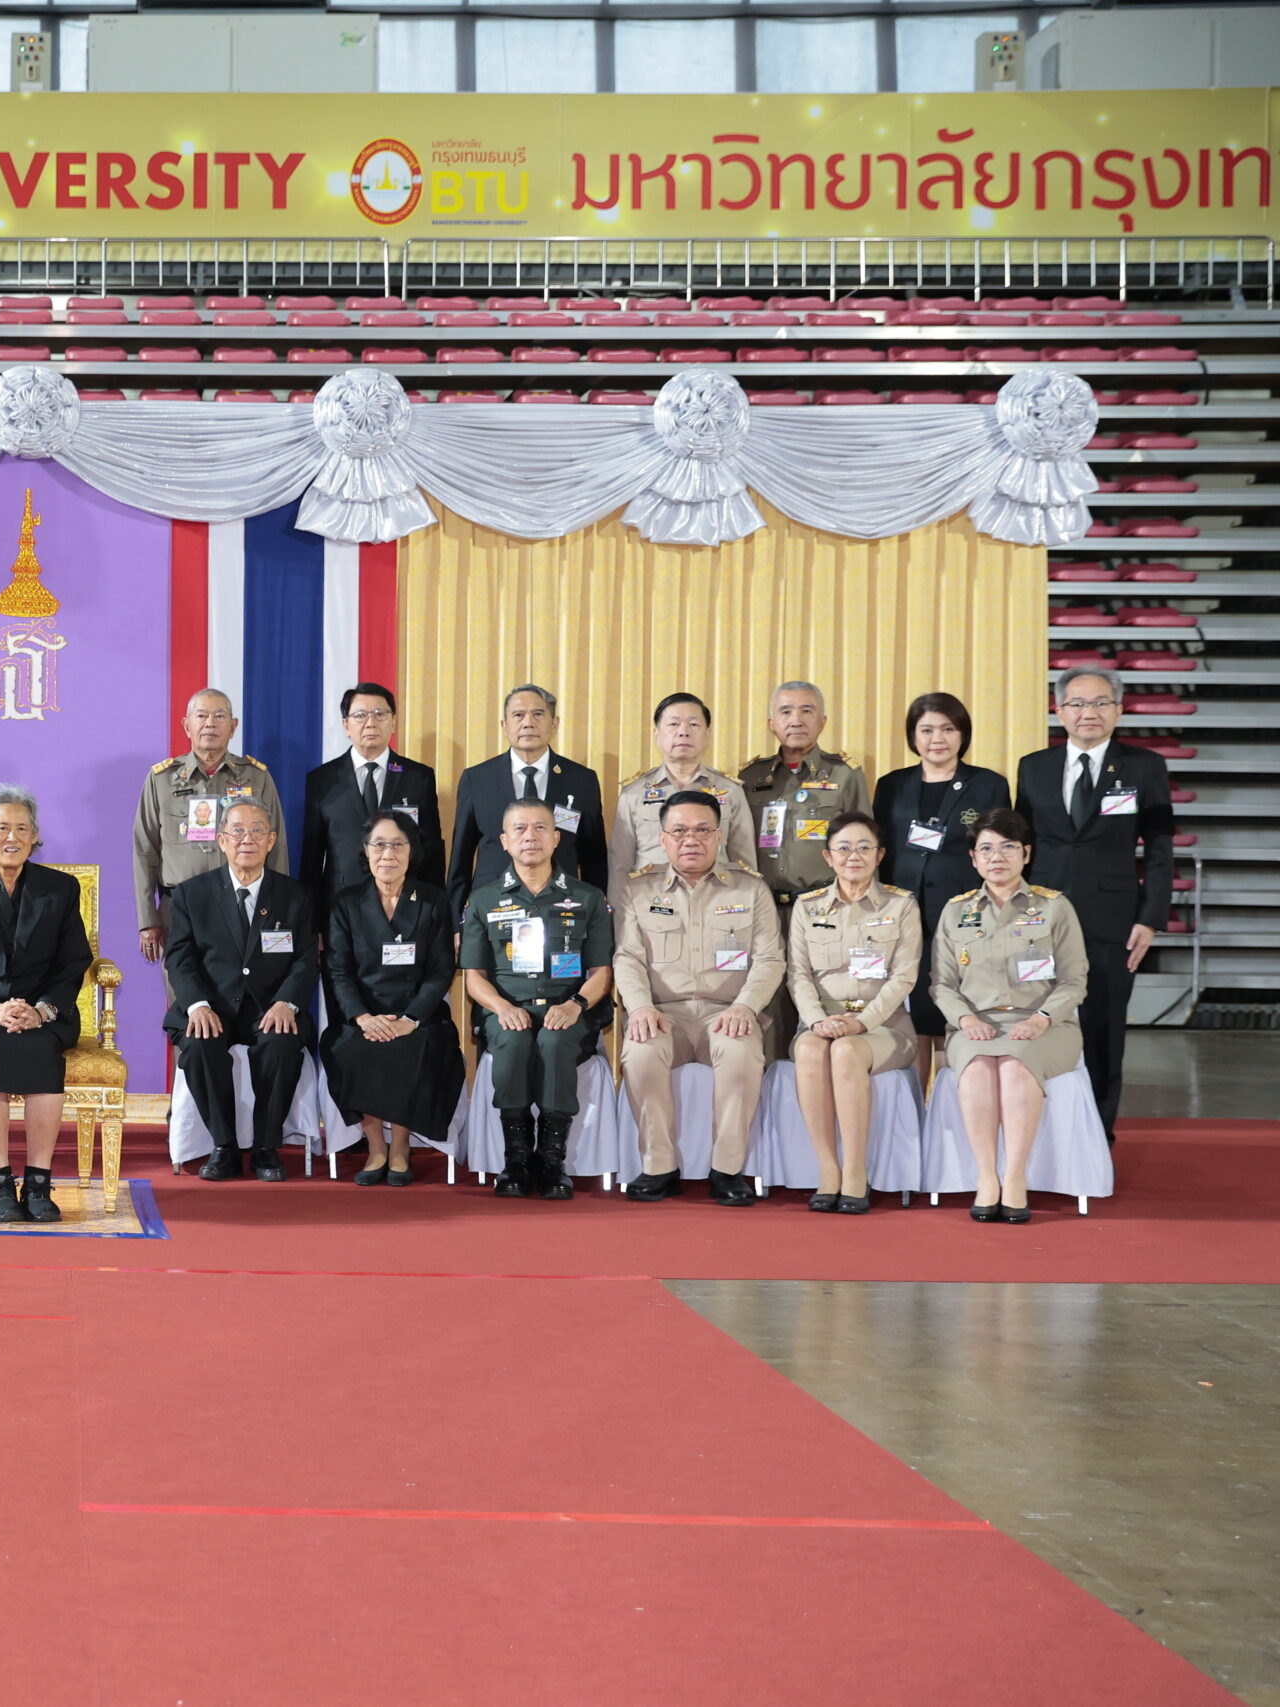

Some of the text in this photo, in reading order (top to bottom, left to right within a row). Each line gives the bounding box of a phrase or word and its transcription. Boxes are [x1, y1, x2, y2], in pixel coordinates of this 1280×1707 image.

[432, 147, 527, 167] กรุงเทพธนบุรี
[431, 170, 529, 214] BTU
[572, 128, 1280, 232] มหาวิทยาลัยกรุงเท
